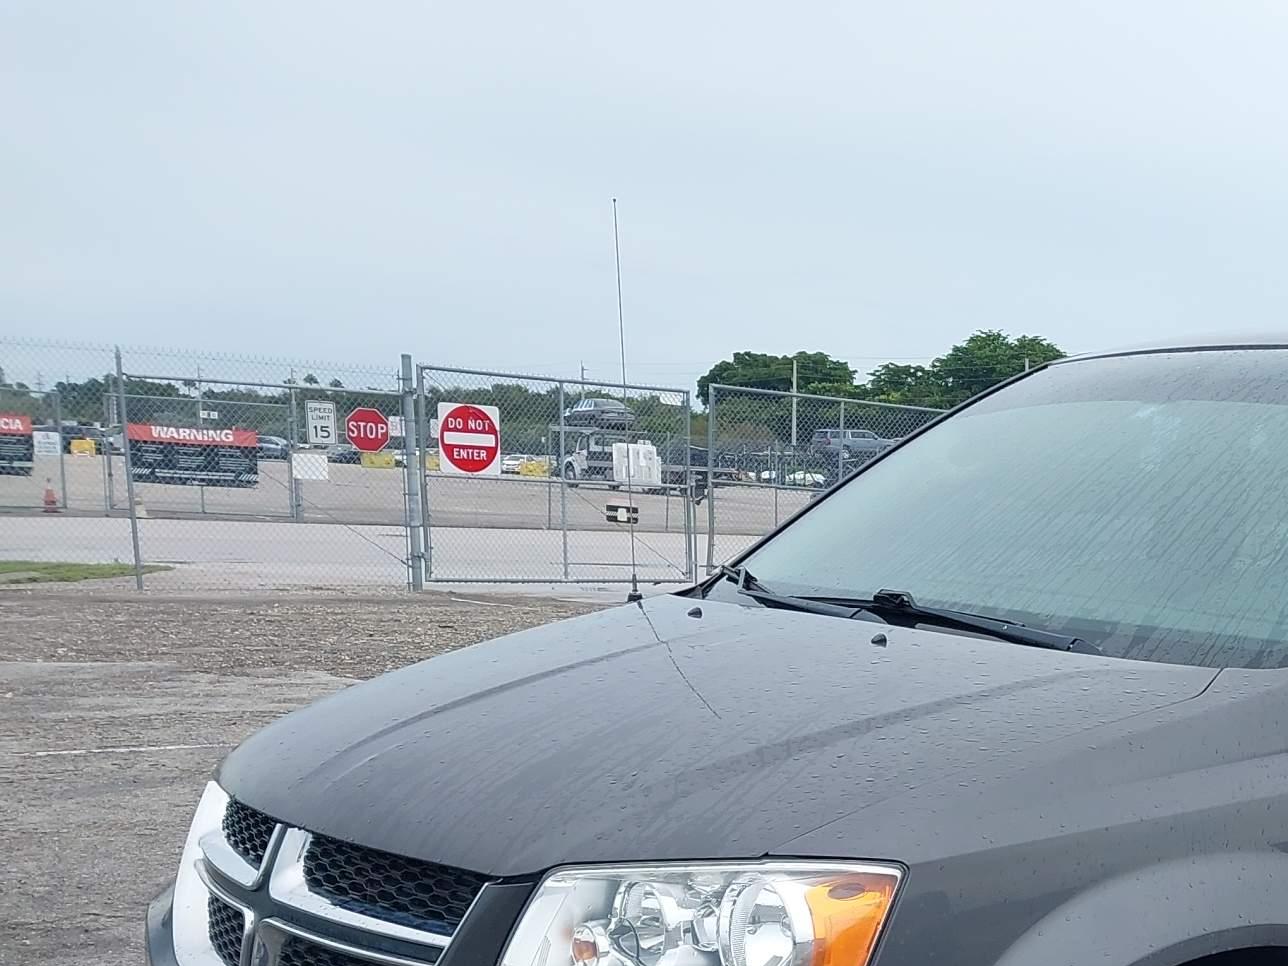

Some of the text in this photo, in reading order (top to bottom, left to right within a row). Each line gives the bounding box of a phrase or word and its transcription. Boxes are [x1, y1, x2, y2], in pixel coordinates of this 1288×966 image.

[308, 406, 333, 414] SPEED
[348, 421, 387, 439] STOP
[447, 417, 463, 429] DO
[468, 418, 490, 431] NOT
[150, 425, 234, 442] WARNING
[313, 425, 331, 439] 15
[453, 447, 487, 460] ENTER
